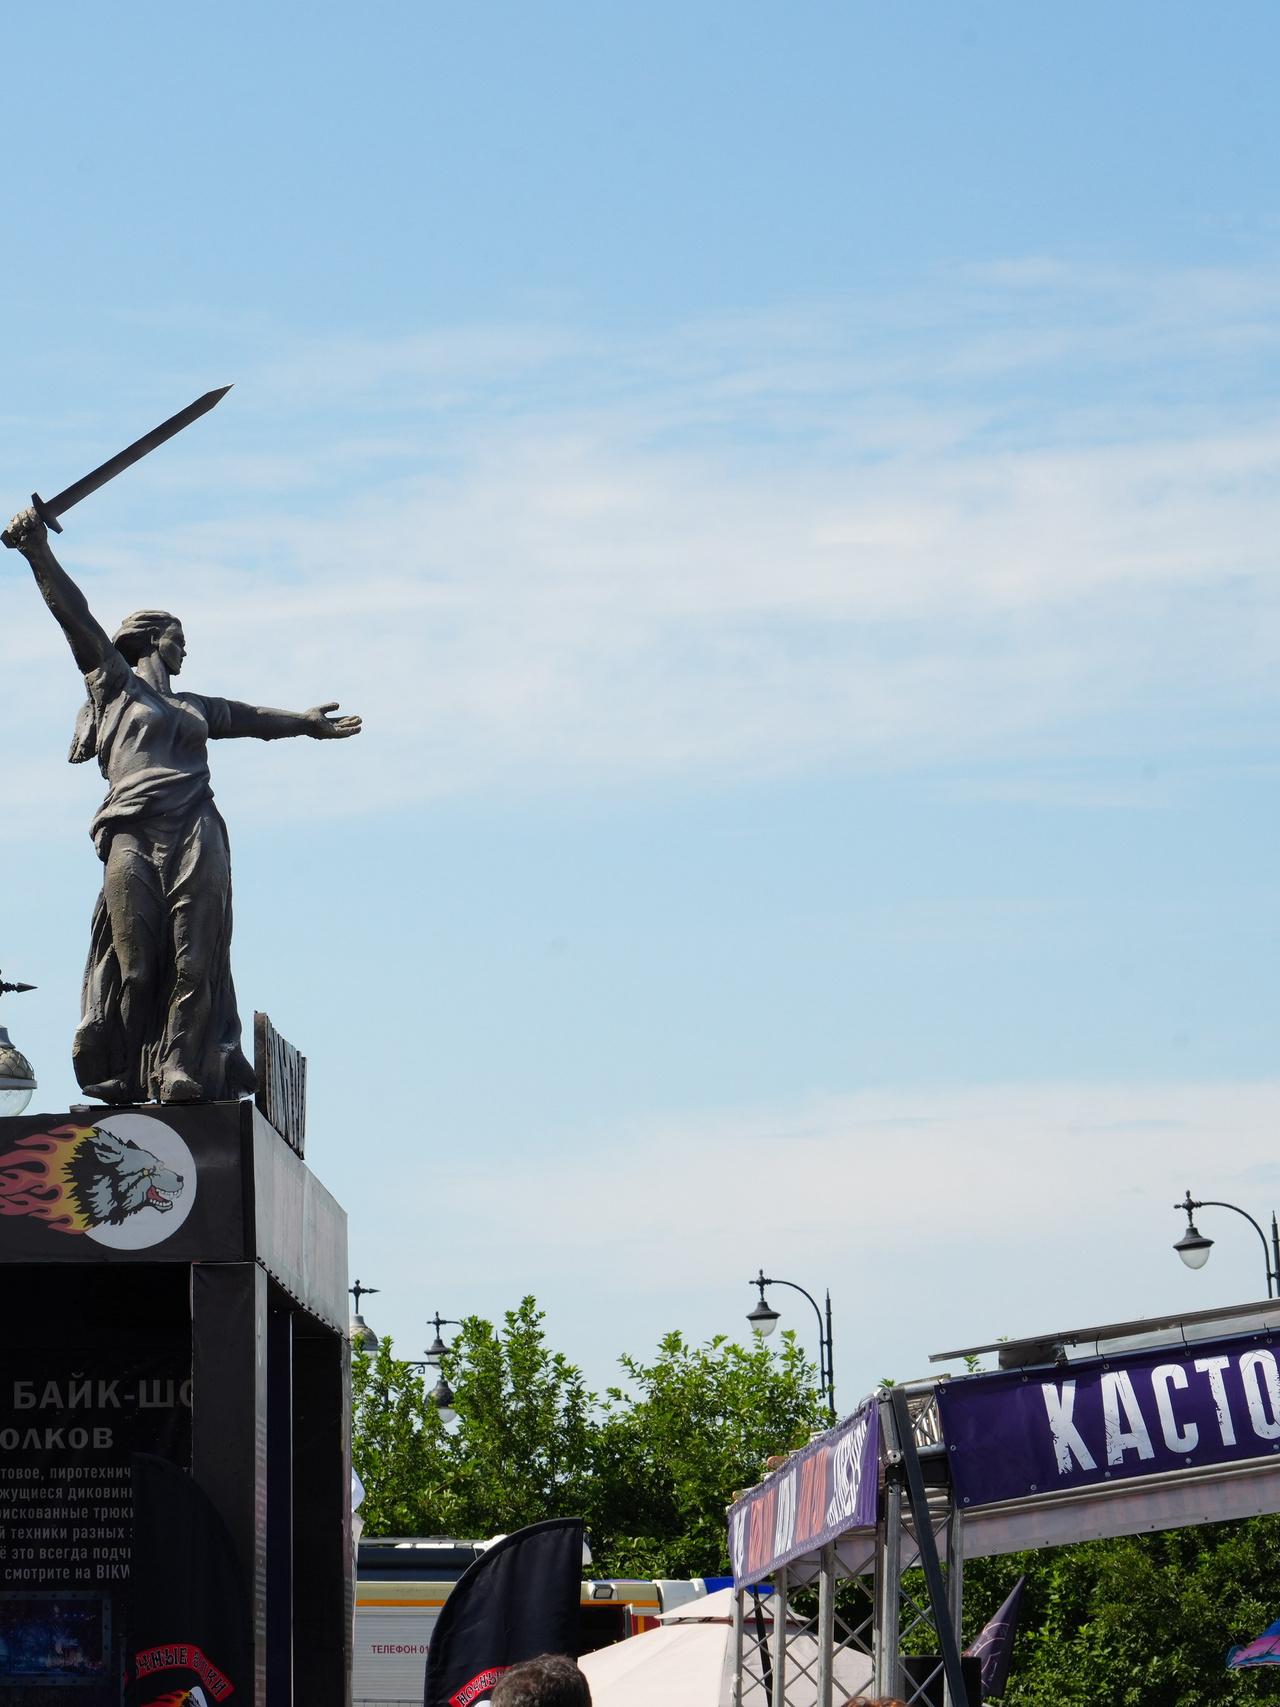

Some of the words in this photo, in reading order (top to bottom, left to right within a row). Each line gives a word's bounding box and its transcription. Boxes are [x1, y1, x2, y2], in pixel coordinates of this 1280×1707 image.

[1041, 1348, 1280, 1475] КАСТО
[10, 1527, 68, 1539] техники
[72, 1527, 124, 1542] разных
[11, 1548, 34, 1560] это
[39, 1547, 87, 1562] всегда
[4, 1567, 70, 1582] смотрите
[75, 1567, 91, 1579] на
[371, 1644, 417, 1654] ТЕЛЕФОН
